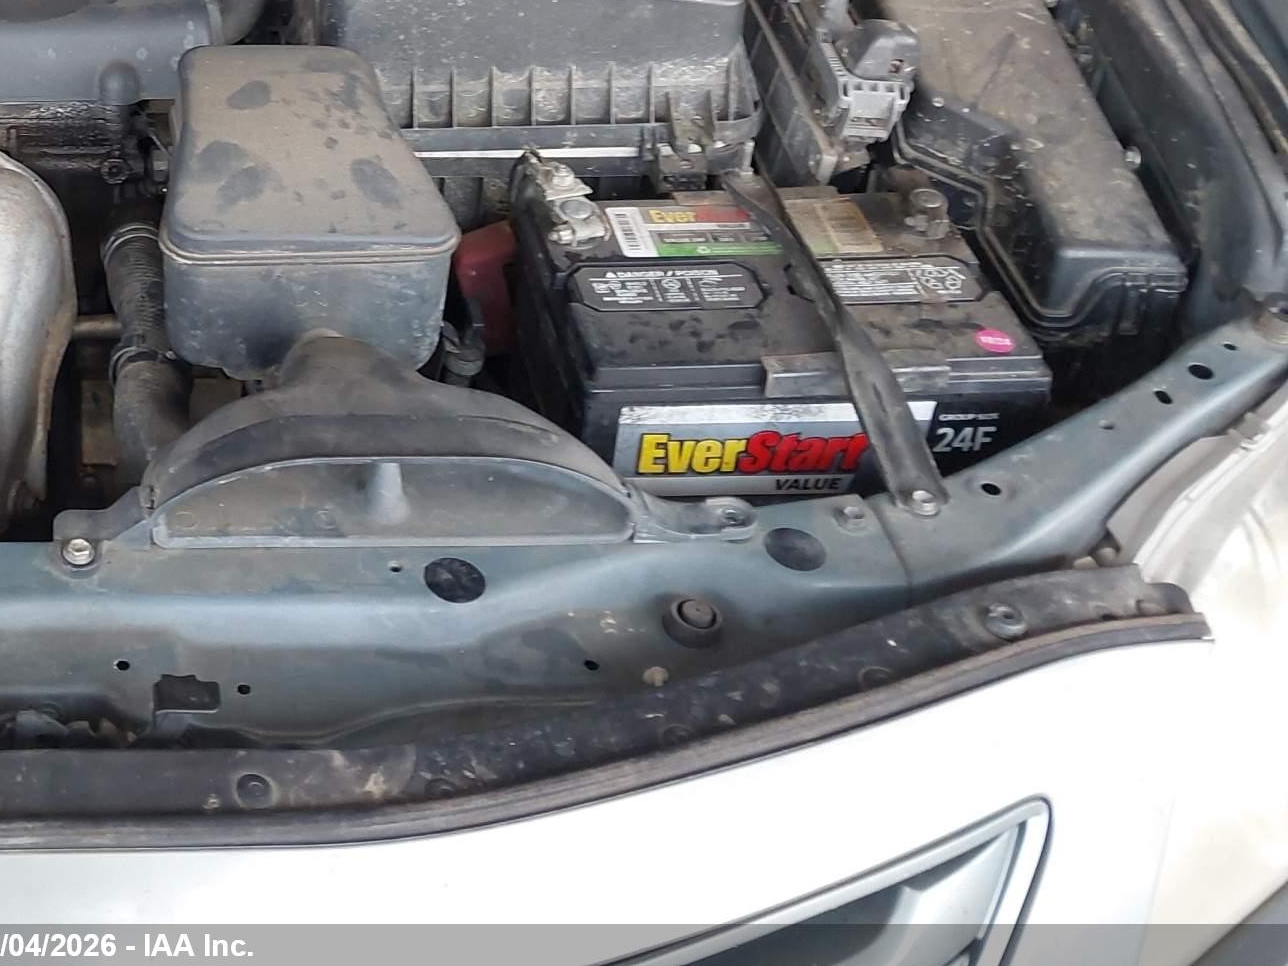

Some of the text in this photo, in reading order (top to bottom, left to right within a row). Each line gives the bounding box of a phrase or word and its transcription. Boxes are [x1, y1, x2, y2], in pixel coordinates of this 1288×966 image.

[637, 430, 869, 474] EverStart
[933, 426, 998, 453] 24F
[775, 478, 842, 491] VALUE
